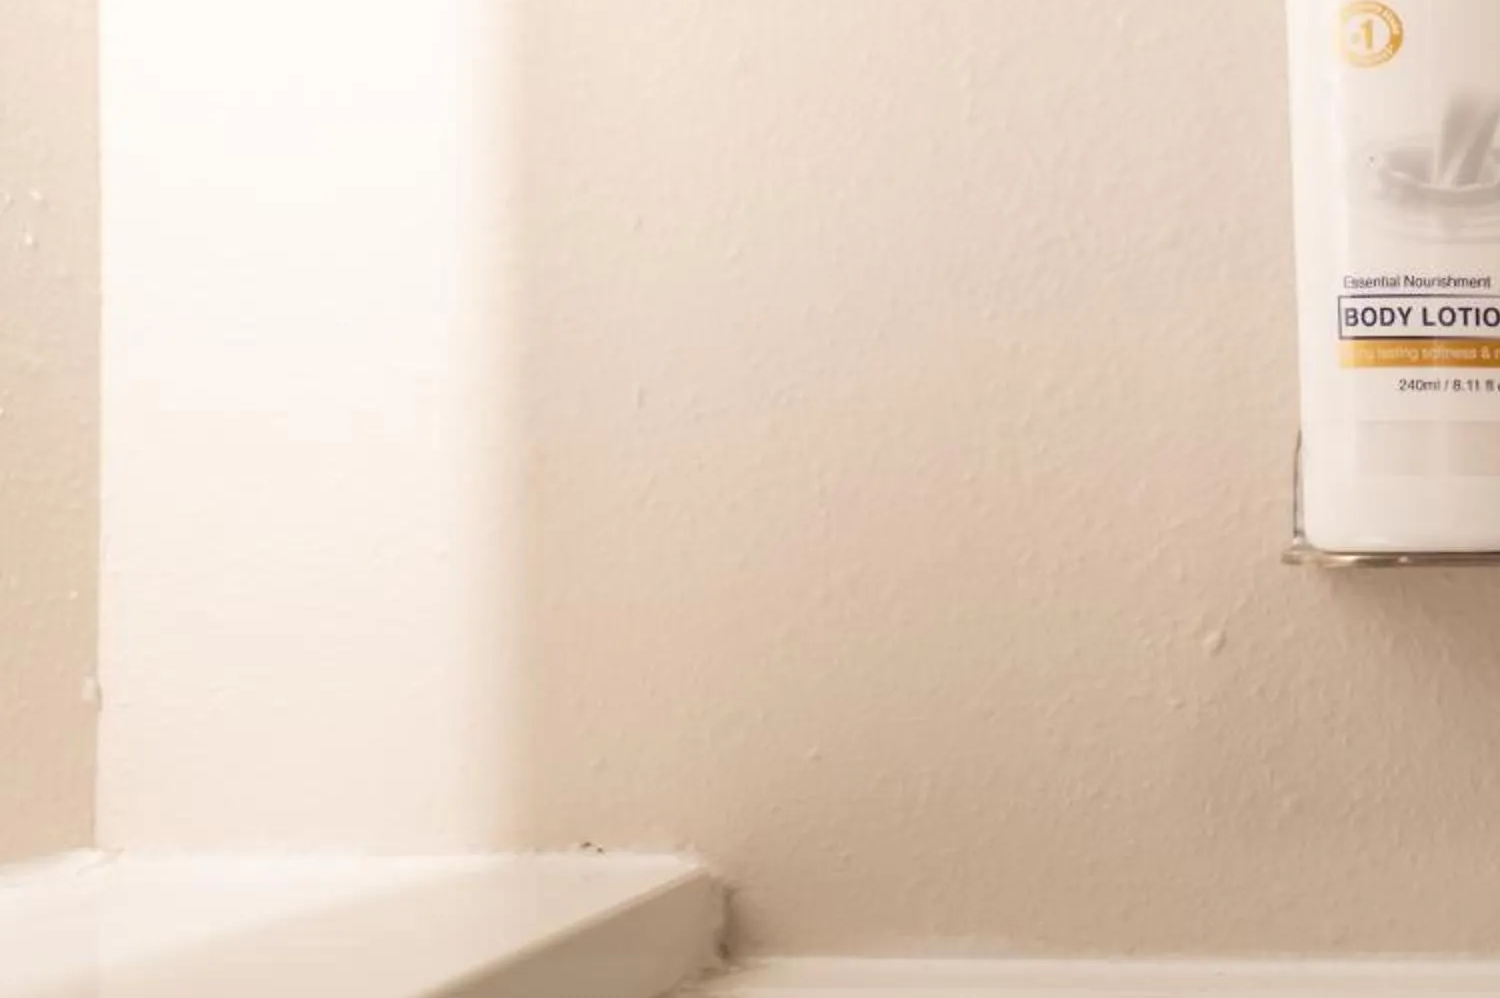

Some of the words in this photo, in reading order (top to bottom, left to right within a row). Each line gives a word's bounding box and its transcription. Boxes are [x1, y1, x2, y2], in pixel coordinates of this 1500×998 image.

[1343, 275, 1400, 289] Essential
[1403, 275, 1492, 289] Nourishment
[1344, 305, 1413, 328] BODY
[1398, 378, 1442, 392] 240ml
[1452, 378, 1481, 392] 8.11
